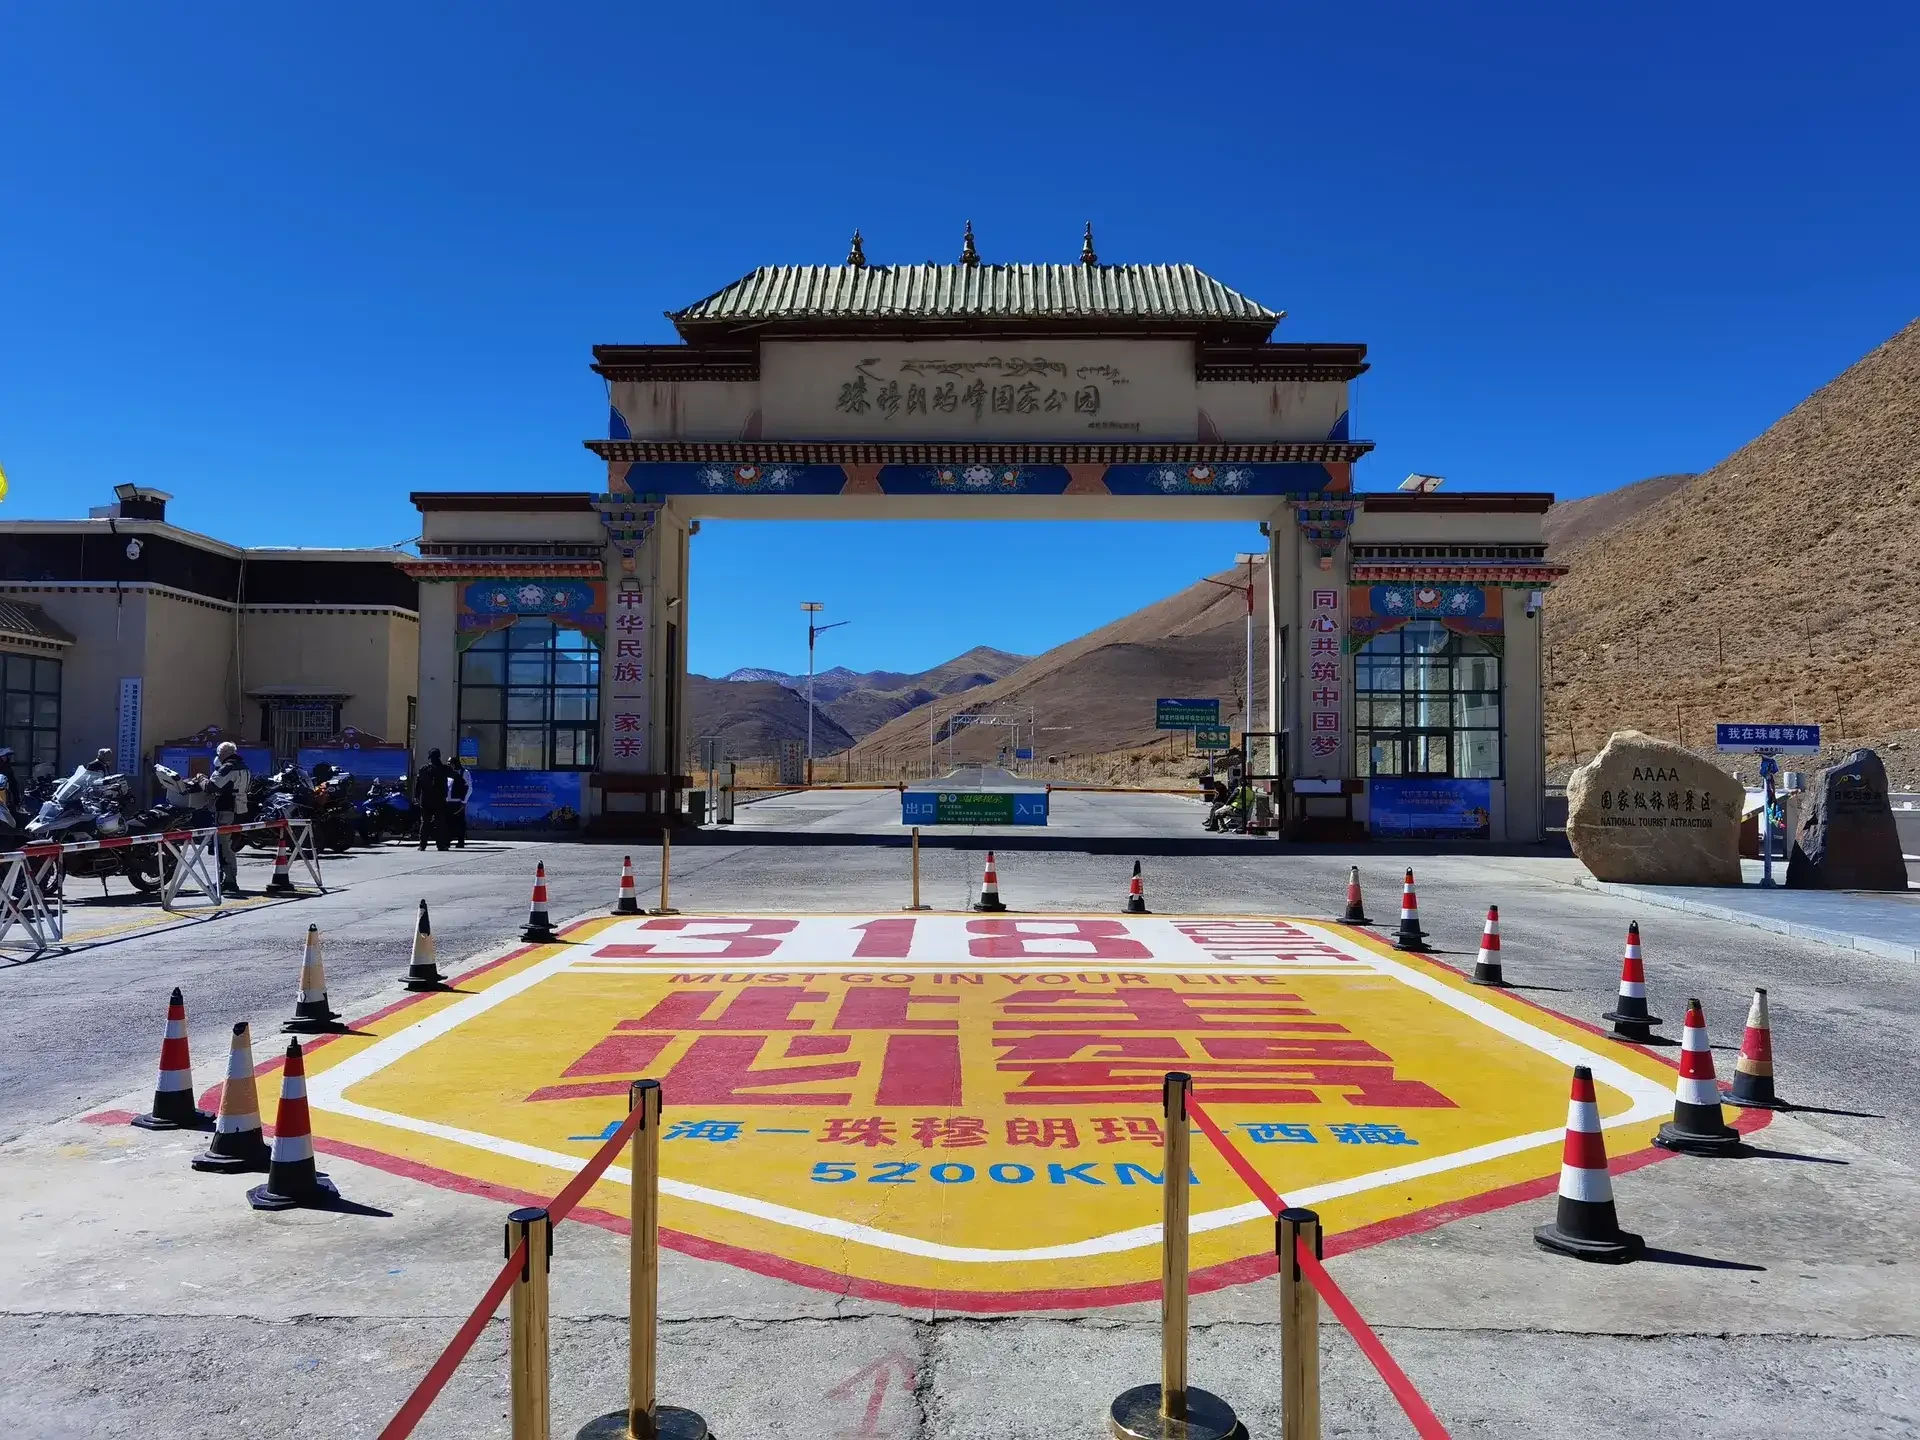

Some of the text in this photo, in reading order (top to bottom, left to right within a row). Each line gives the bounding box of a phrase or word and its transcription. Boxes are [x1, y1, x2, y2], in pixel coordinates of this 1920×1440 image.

[835, 376, 1102, 421] 珠穆朗玛峰国家公园
[613, 590, 644, 758] 中华民族一家亲
[1310, 589, 1341, 758] 同心共筑中国梦
[1728, 727, 1809, 741] 我在珠峰等你
[1632, 767, 1680, 782] AAAA
[906, 802, 933, 815] 出口
[1016, 803, 1044, 815] 入口
[1601, 790, 1711, 812] 国家级旅游景区
[1600, 817, 1712, 828] NATIONAL TOURIST ATTRACTION
[590, 918, 1154, 959] 318
[1169, 920, 1359, 962] ROUTE
[668, 973, 1286, 985] MUST GO IN YOUR LIFE
[613, 985, 1352, 1033] 此生
[523, 1033, 1461, 1108] 必驾
[811, 1161, 1200, 1185] 5200KM
